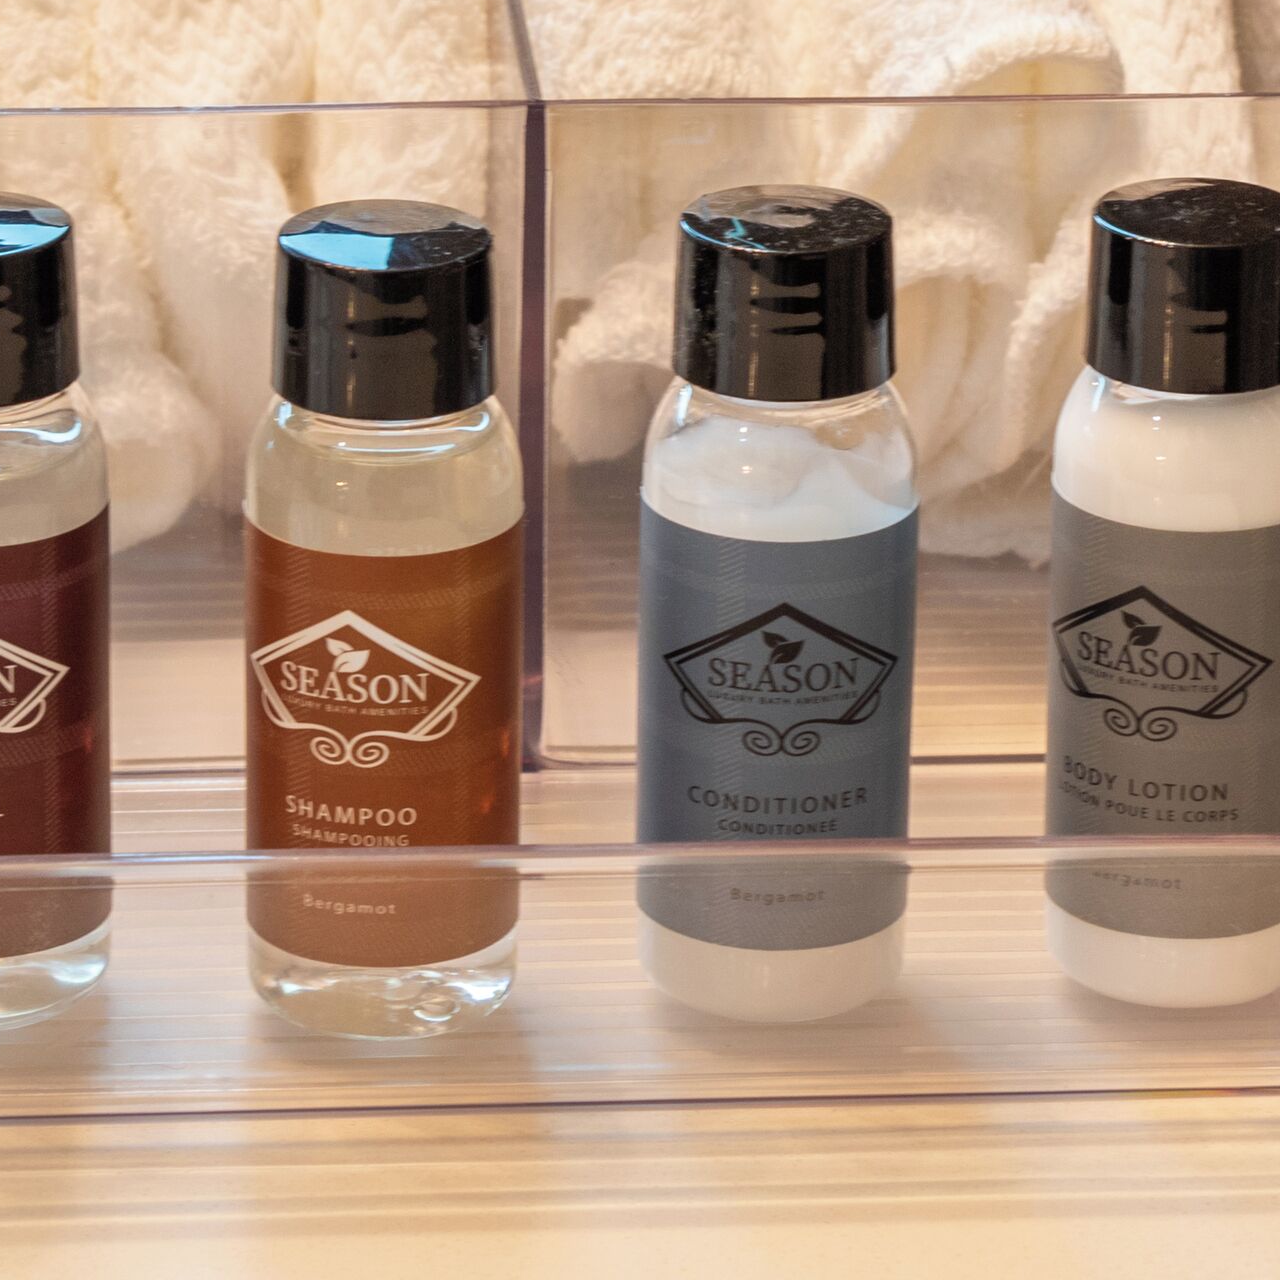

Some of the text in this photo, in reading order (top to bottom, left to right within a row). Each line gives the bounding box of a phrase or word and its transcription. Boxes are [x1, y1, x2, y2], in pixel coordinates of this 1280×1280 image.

[1078, 631, 1220, 680] SEASON
[280, 661, 430, 704] SEASON
[708, 657, 859, 693] SEASON
[324, 703, 358, 714] BATH
[359, 705, 430, 716] AMENITIES
[1063, 755, 1229, 802] BODY LOTION
[285, 794, 418, 827] SHAMPOO
[686, 785, 868, 815] CONDITIONER
[1156, 809, 1176, 822] LE
[1182, 808, 1240, 823] CORPS
[291, 823, 410, 847] SHAMPOOING
[302, 892, 397, 915] Bergamot
[729, 887, 825, 906] Bergamot
